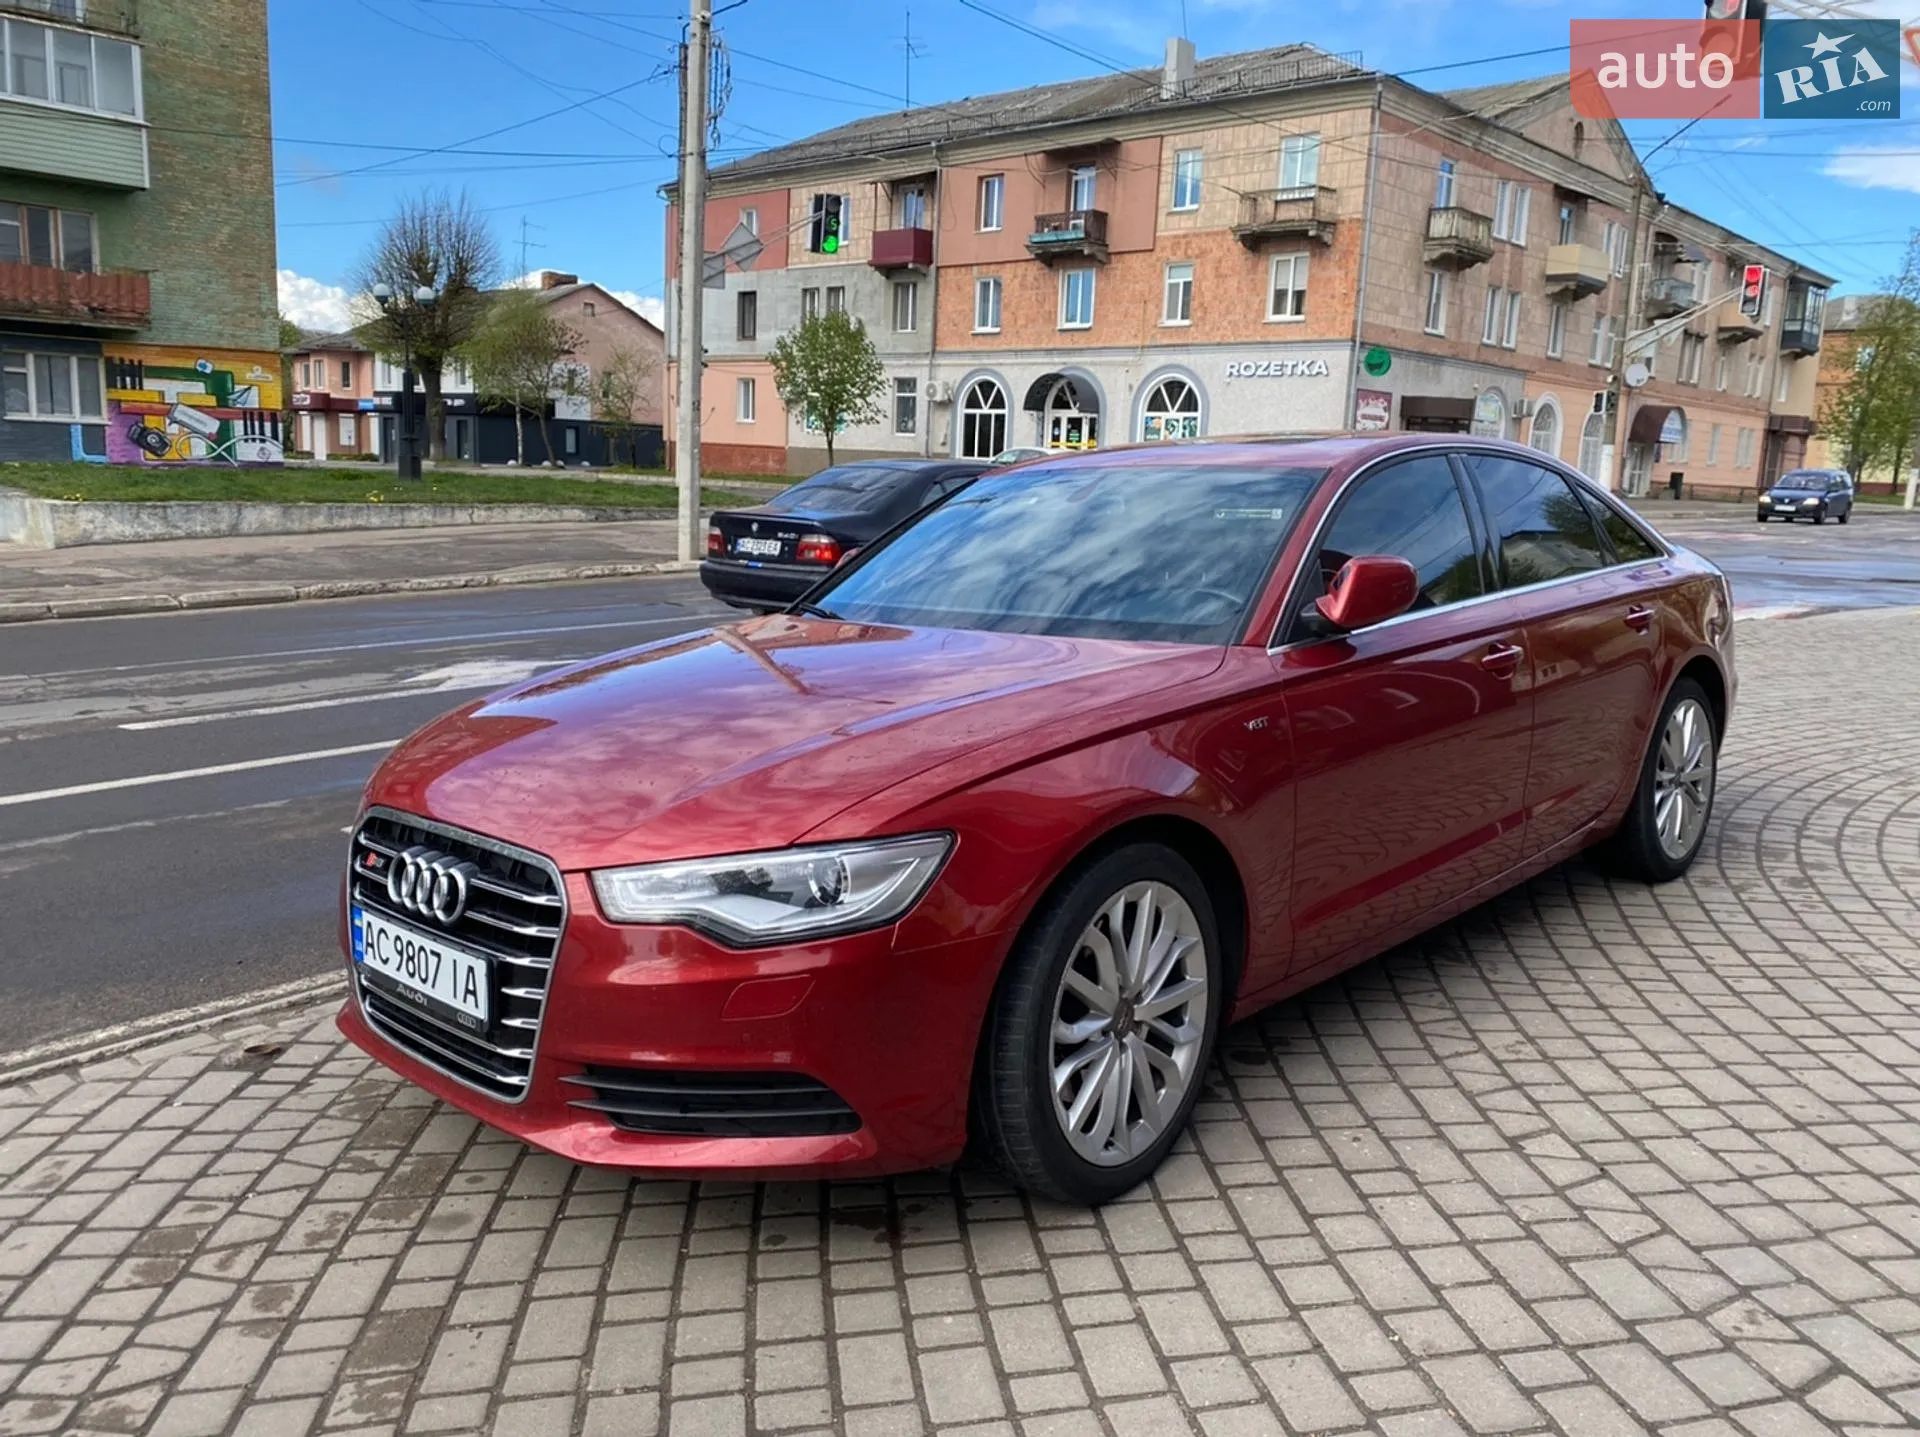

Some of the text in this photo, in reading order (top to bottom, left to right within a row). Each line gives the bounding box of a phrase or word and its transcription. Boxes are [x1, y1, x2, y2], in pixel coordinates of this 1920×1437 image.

[1226, 359, 1329, 377] ROZETKA
[365, 921, 479, 1010] AC 9807 IA
